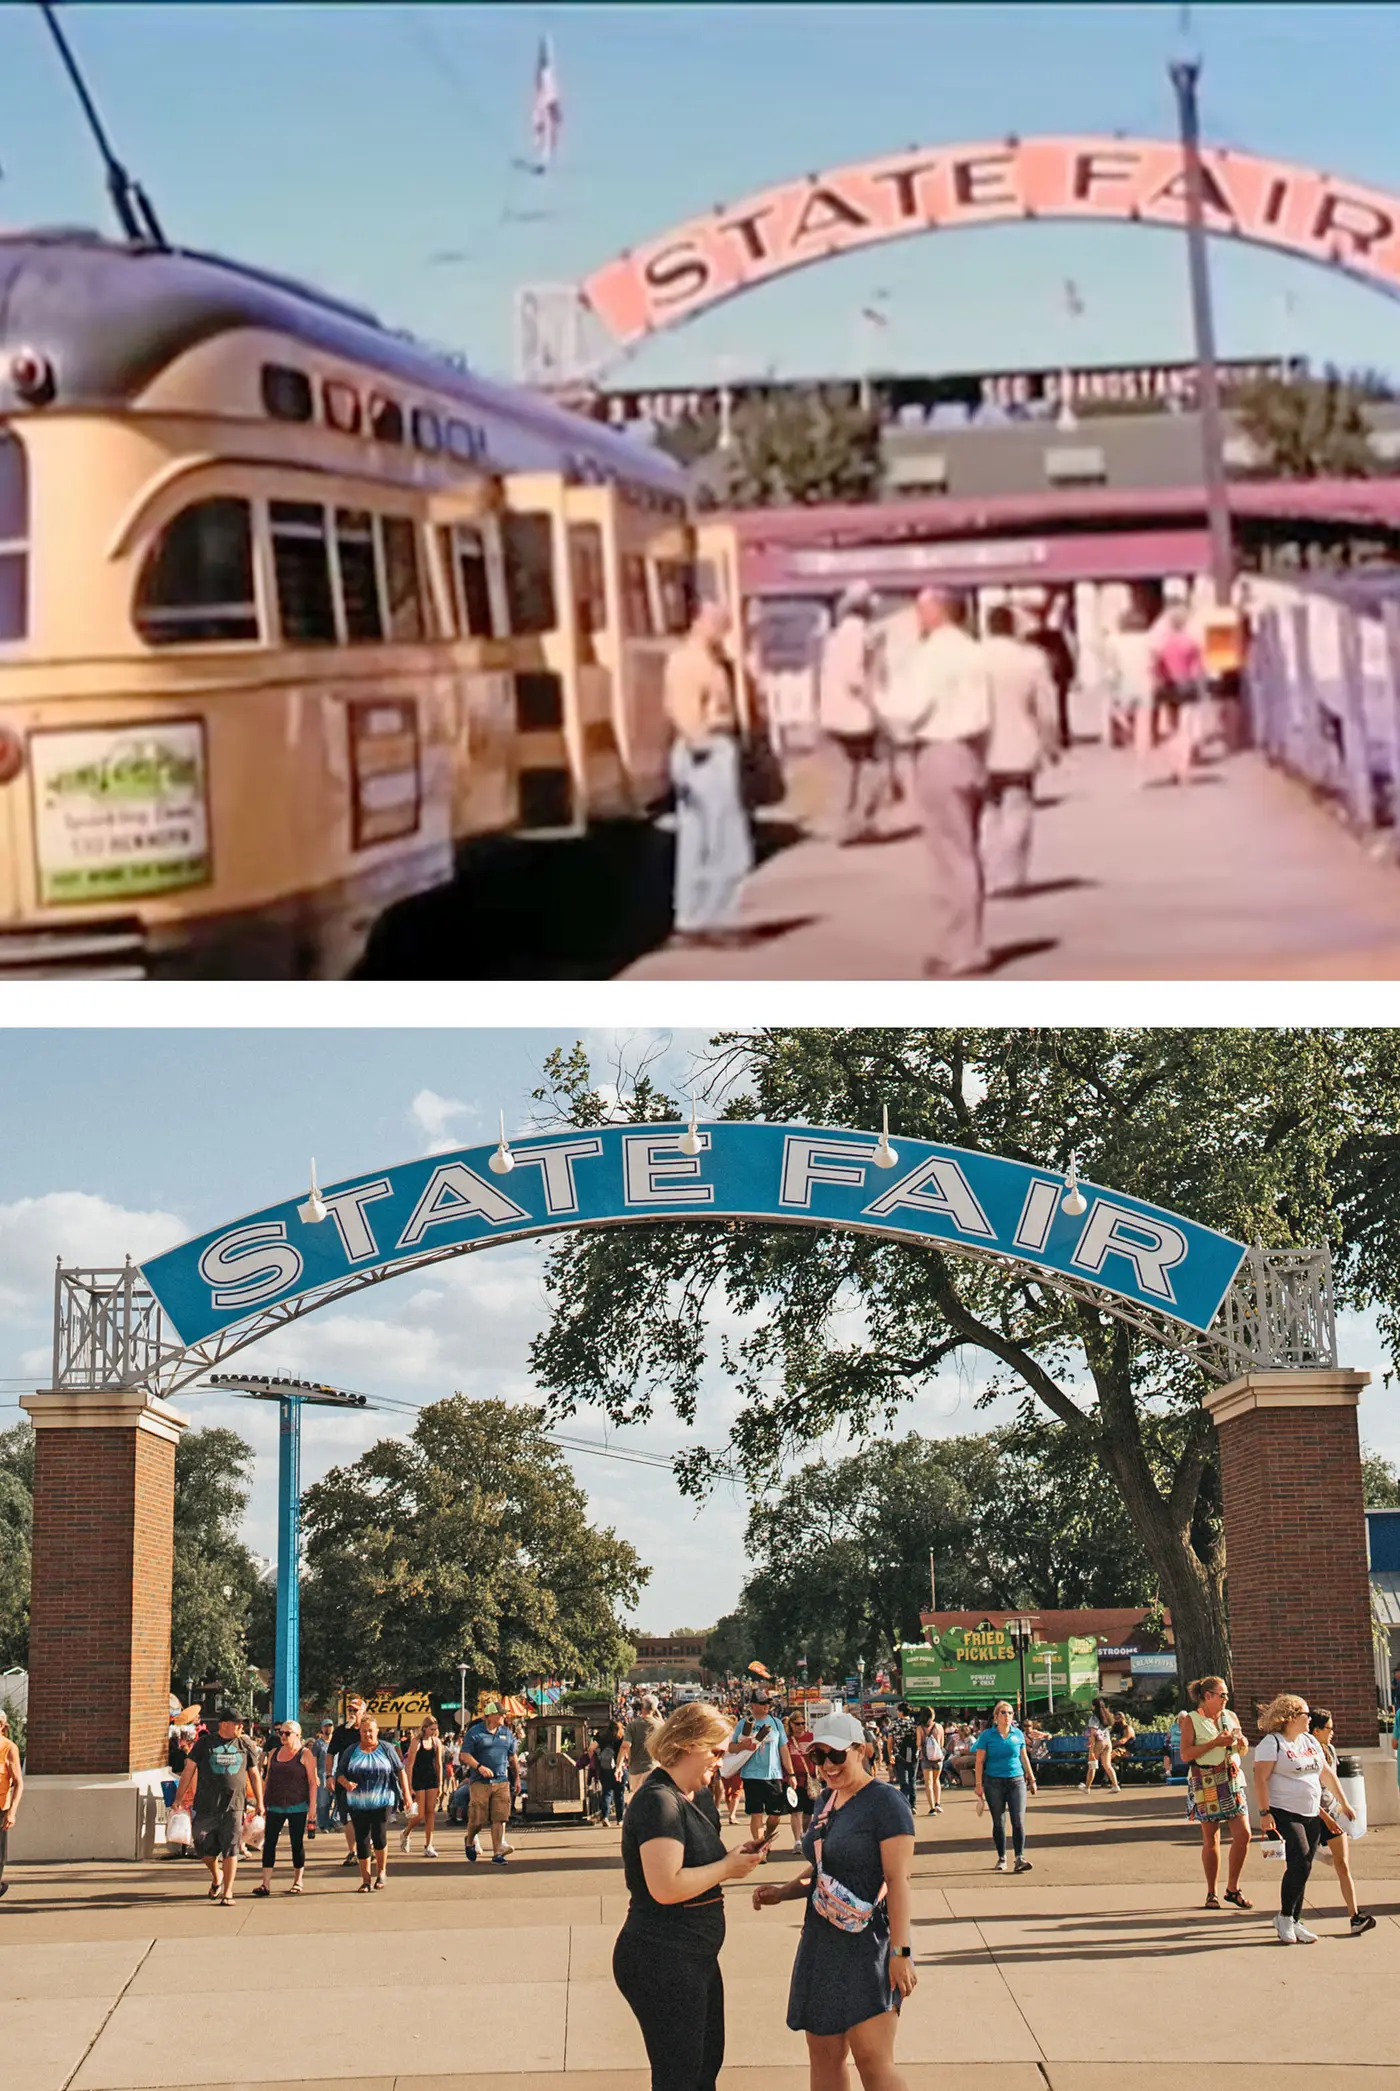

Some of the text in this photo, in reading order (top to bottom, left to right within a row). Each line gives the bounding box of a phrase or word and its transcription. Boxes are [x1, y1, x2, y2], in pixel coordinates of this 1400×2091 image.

[644, 152, 1394, 306] STATE FAIR
[1043, 366, 1199, 402] GANDSTAN
[198, 1131, 1190, 1310] STATE FAIR
[963, 1631, 1005, 1646] FRIED
[956, 1645, 1016, 1661] PICKLES
[1097, 1647, 1139, 1656] STROOMS
[1031, 1655, 1063, 1664] DRKS
[1132, 1657, 1154, 1669] CREAM
[366, 1699, 430, 1713] RENCH
